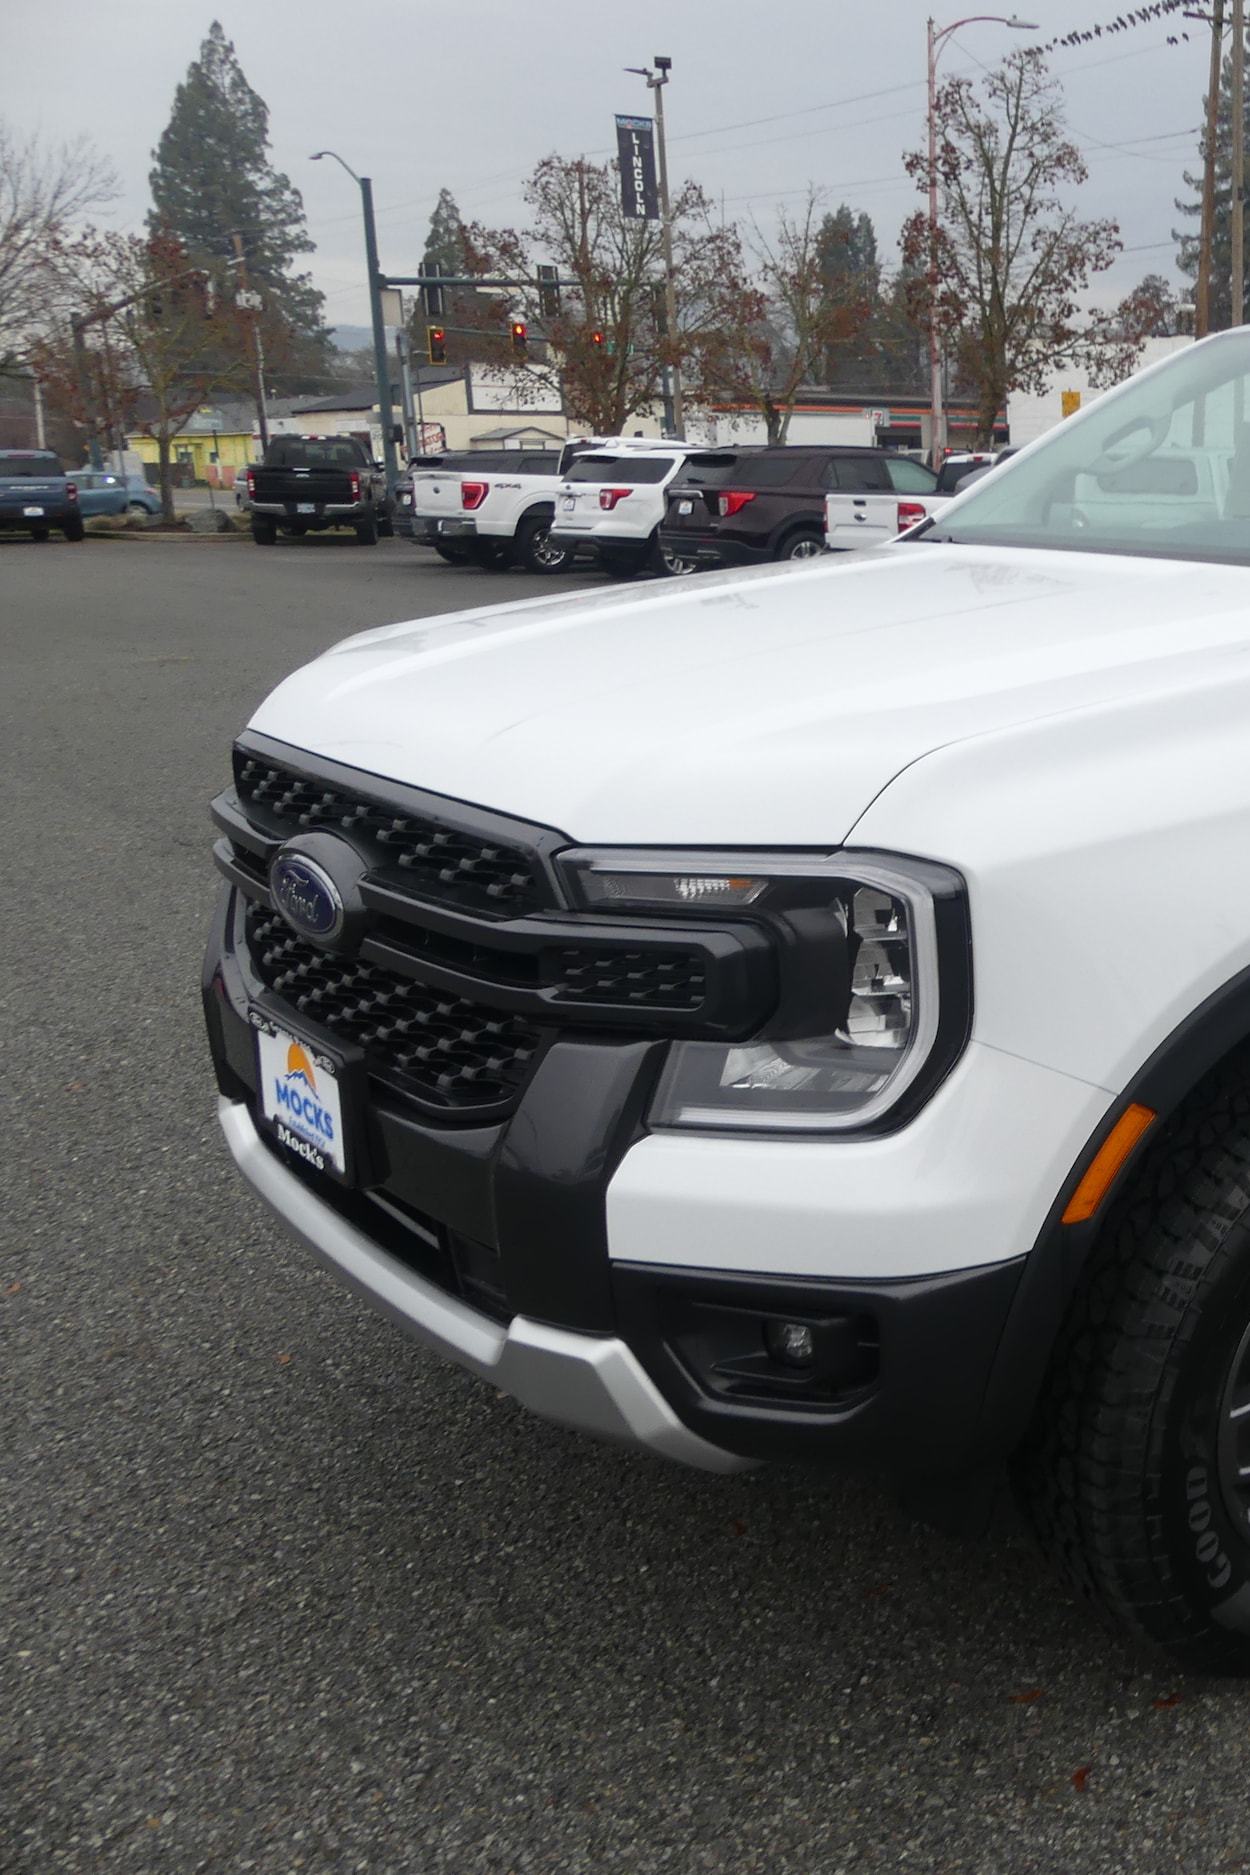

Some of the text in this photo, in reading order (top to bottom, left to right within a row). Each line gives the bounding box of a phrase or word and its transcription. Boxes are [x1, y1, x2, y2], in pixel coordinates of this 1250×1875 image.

[632, 132, 646, 215] LINCOLN
[280, 869, 321, 923] Ford
[274, 1078, 334, 1142] MOCKS
